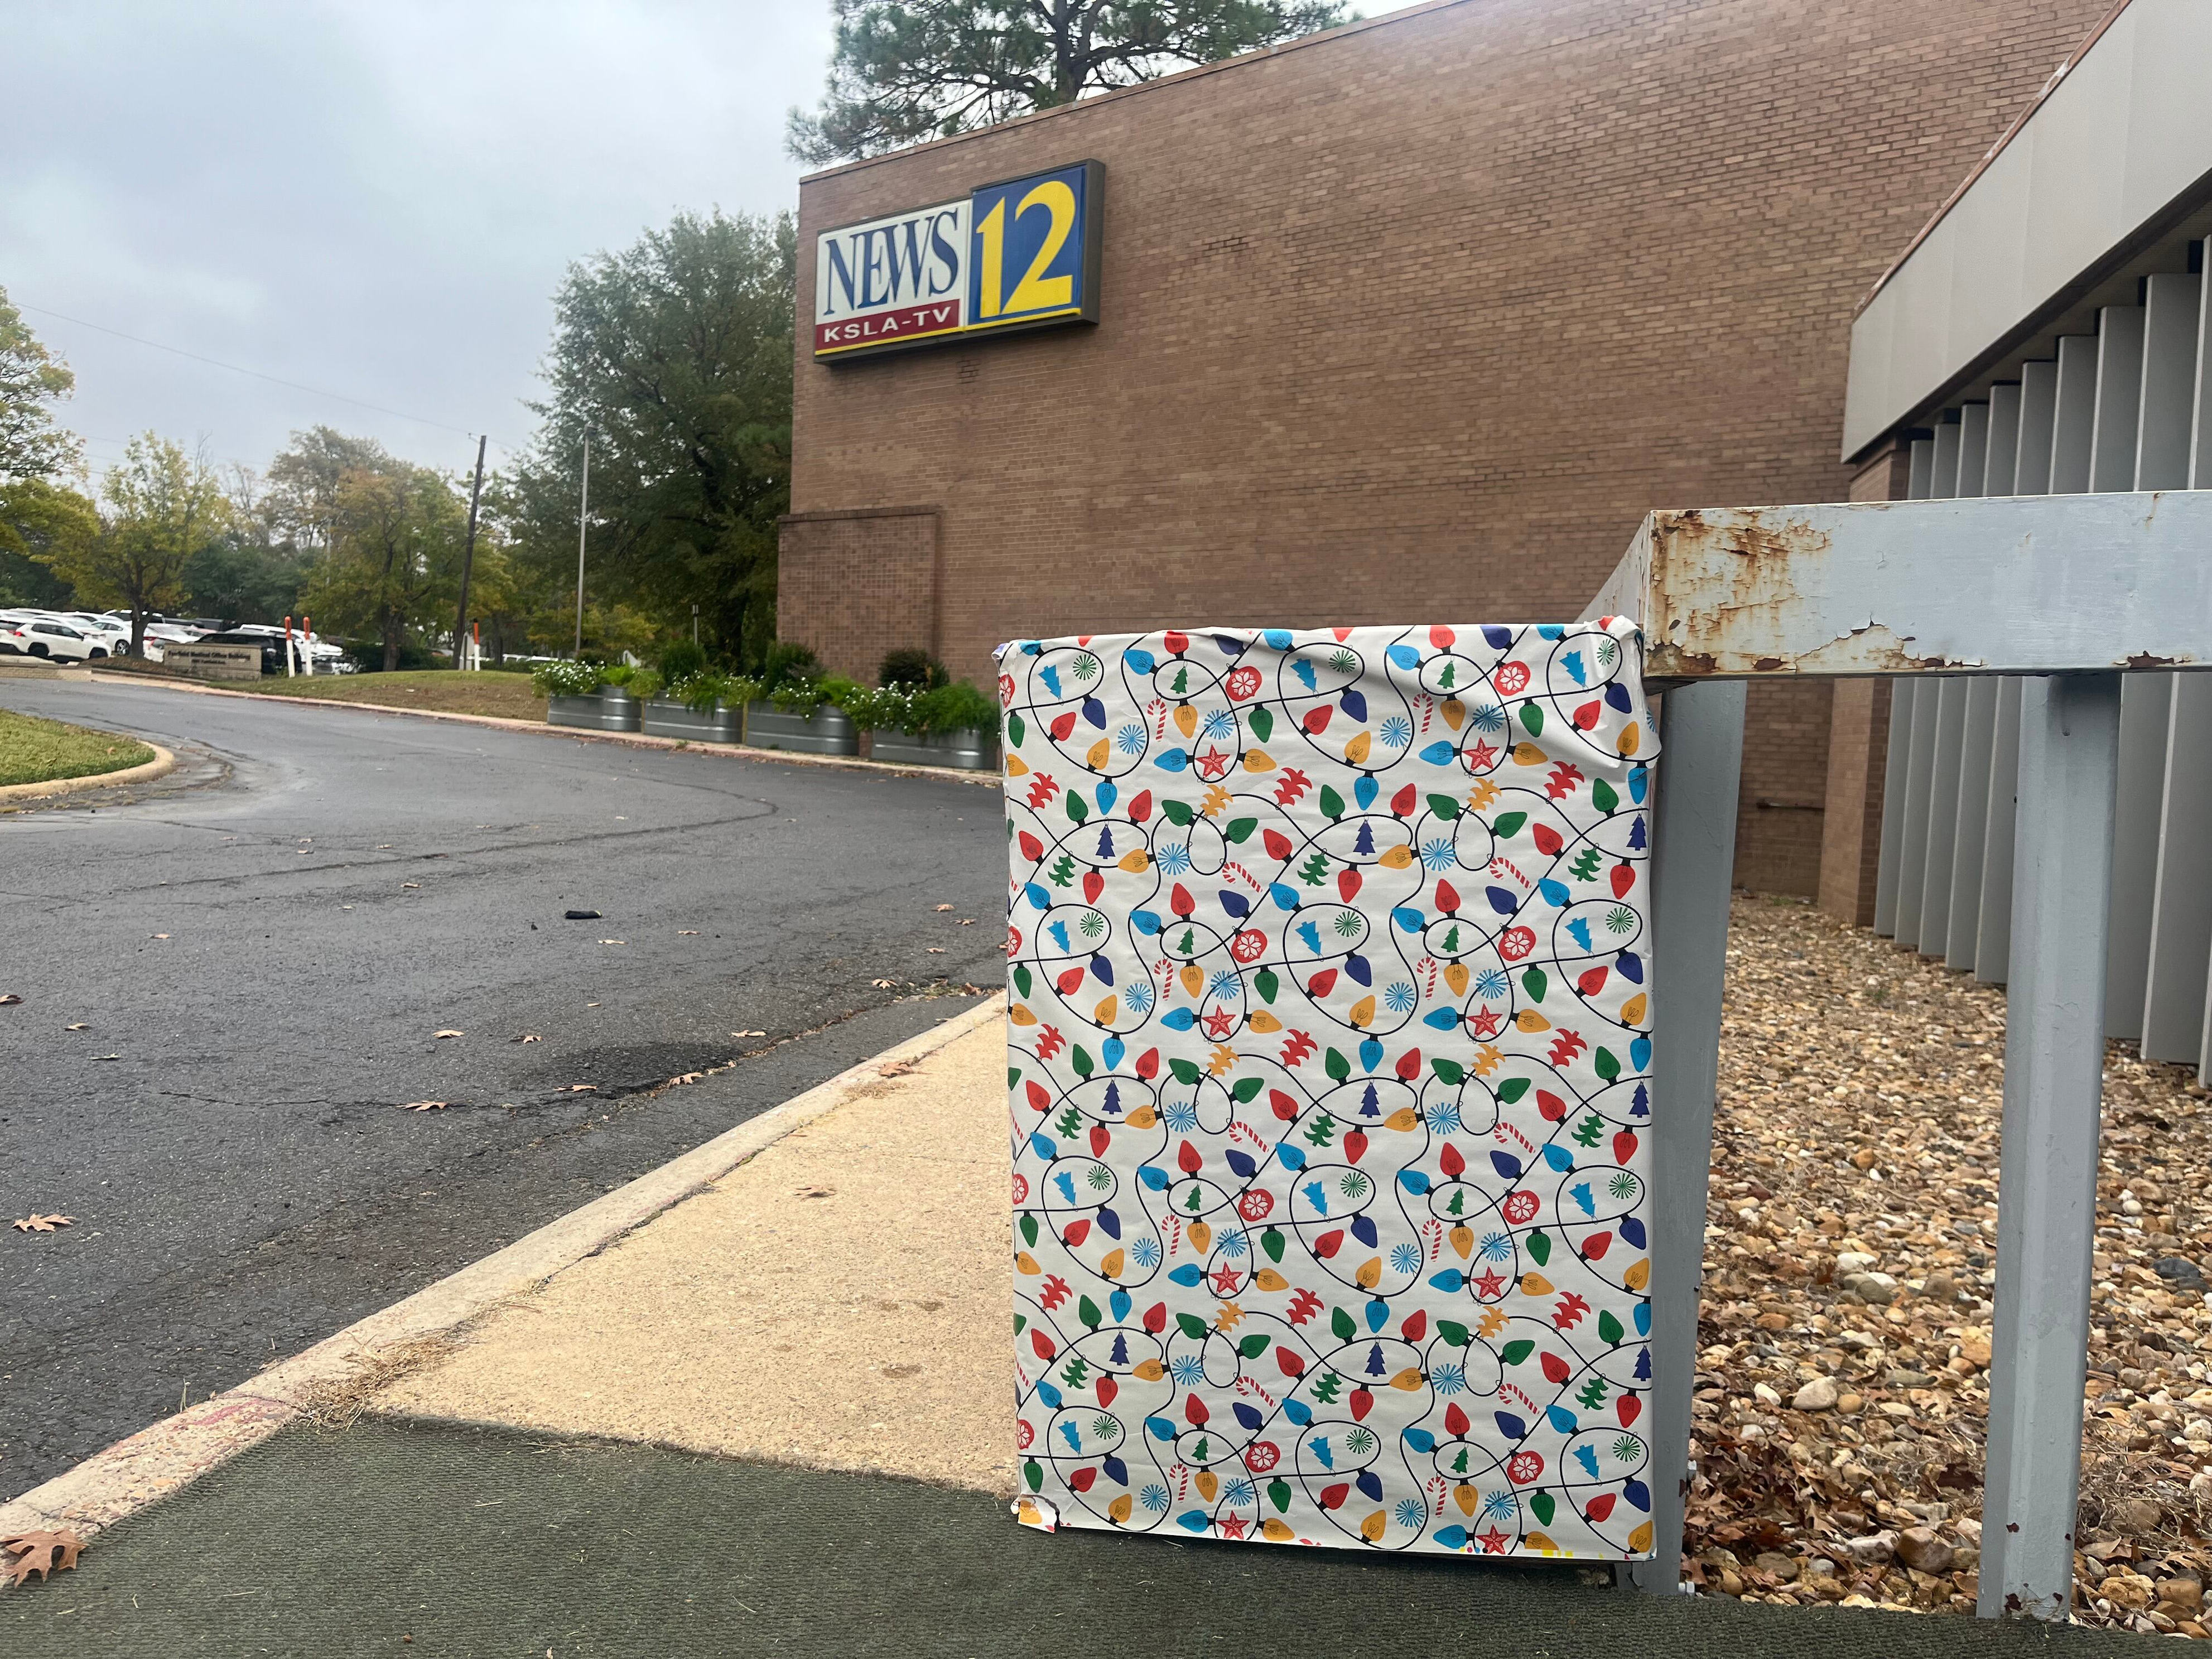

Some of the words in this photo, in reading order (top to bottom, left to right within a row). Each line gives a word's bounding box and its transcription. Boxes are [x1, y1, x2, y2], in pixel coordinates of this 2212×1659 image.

[823, 208, 958, 316] NEWS
[976, 181, 1076, 319] 12
[823, 306, 952, 343] KSLA-TV
